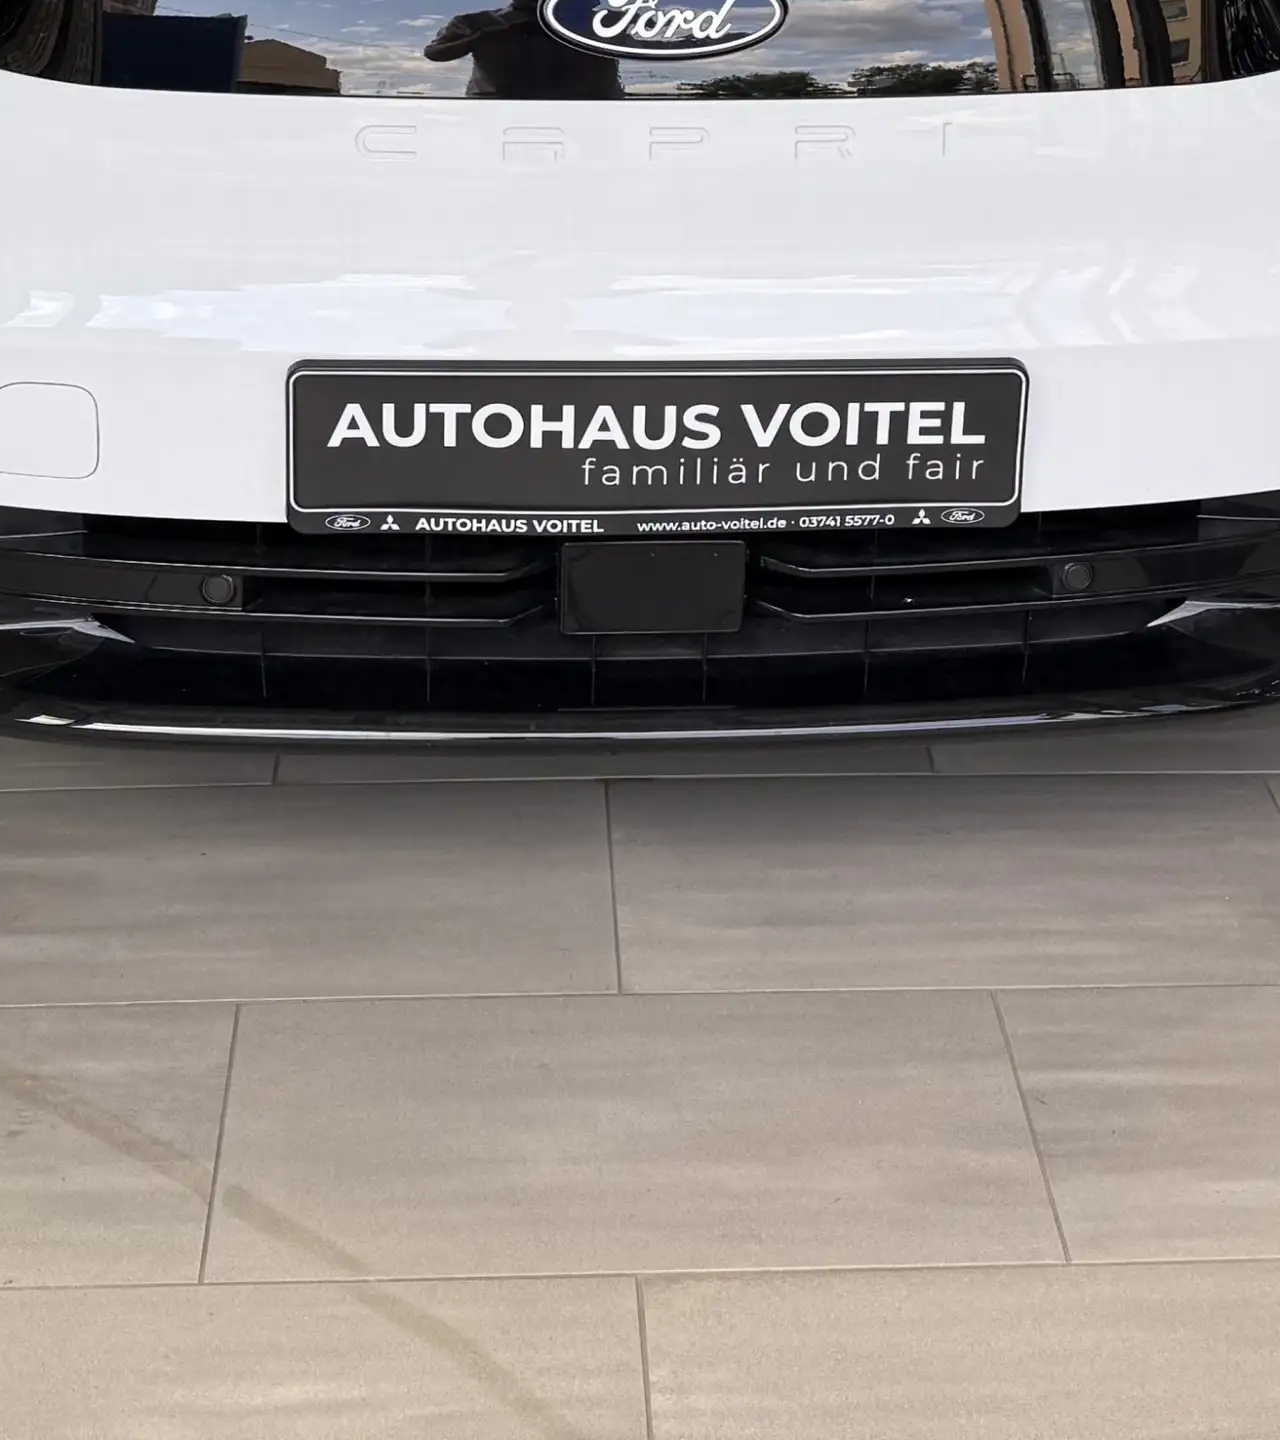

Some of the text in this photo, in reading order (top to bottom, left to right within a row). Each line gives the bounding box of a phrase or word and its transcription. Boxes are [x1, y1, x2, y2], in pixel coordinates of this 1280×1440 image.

[354, 122, 954, 160] CAPRI
[327, 401, 986, 451] AUTOHAUS VOITEL
[582, 451, 985, 486] familiär und fair
[415, 517, 528, 533] AUTOHAUS
[533, 519, 605, 534] VOITEL
[637, 516, 787, 532] www.auto-voitel.de
[799, 515, 841, 529] 03741
[844, 514, 895, 528] 5577-0
